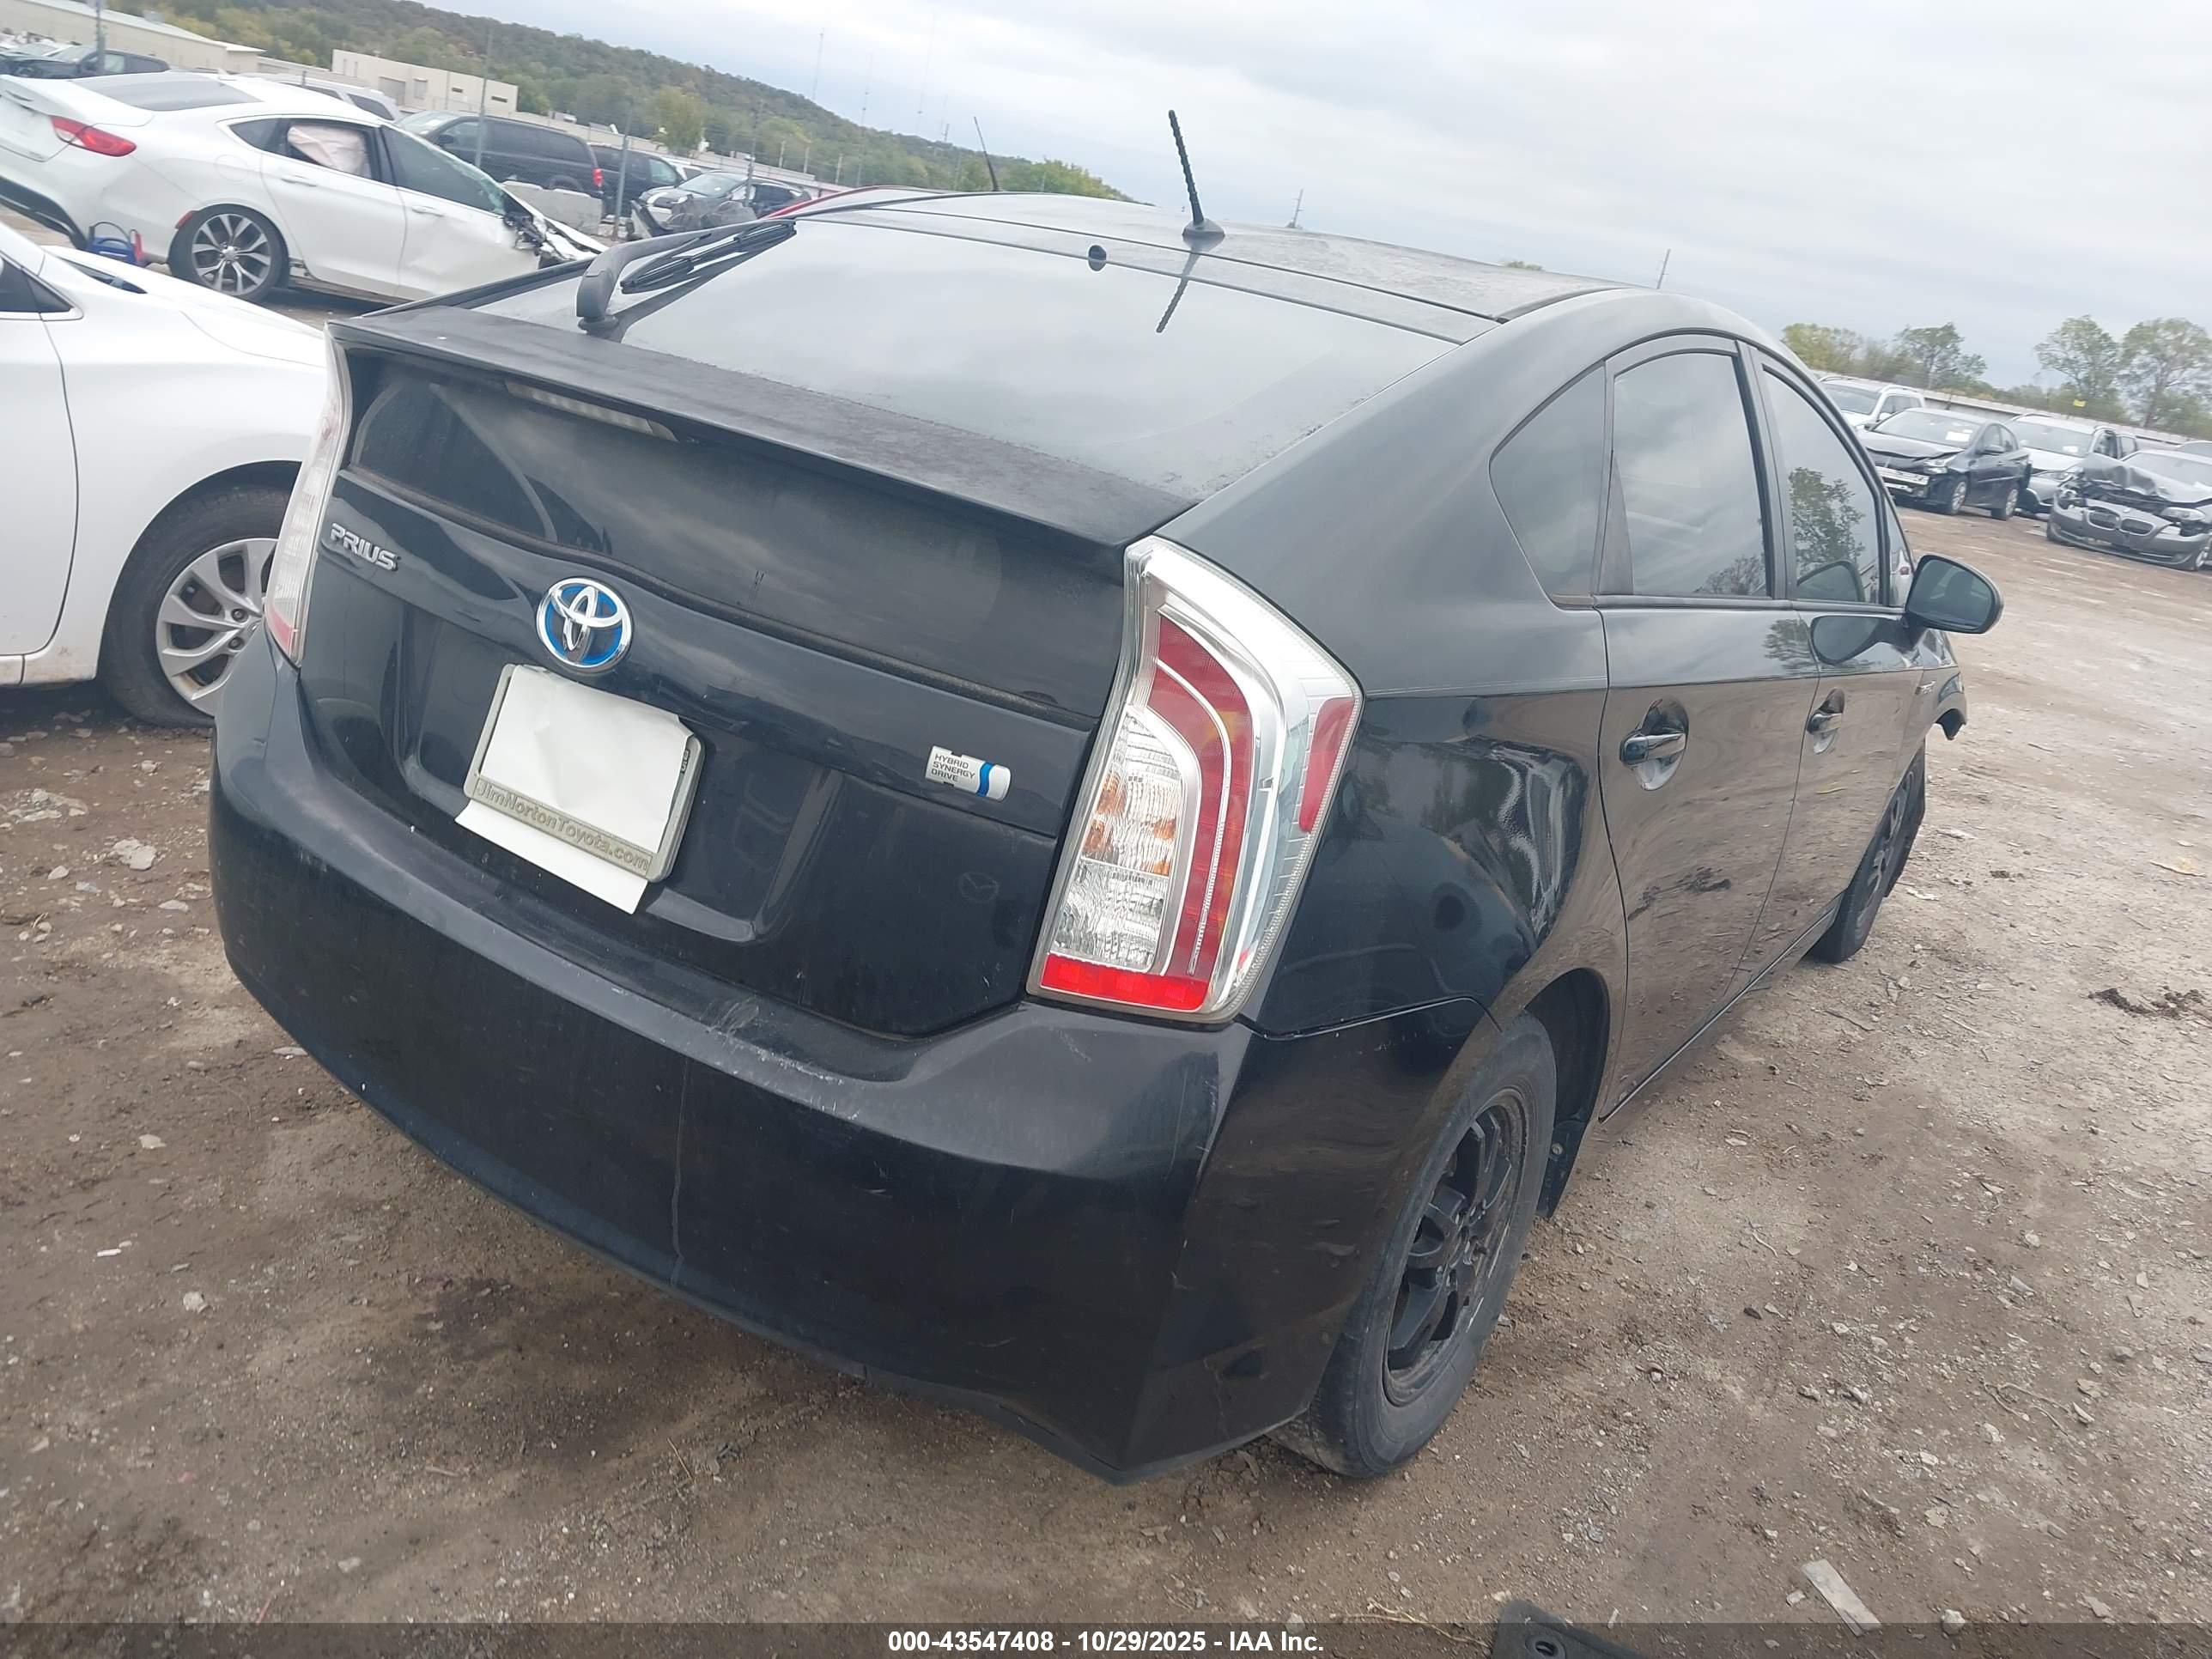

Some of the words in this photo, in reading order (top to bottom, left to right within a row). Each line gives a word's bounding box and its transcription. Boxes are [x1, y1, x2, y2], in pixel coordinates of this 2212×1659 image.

[330, 522, 398, 571] PRIUS
[933, 761, 976, 779] SYNERGY
[934, 753, 969, 769] HYBRID
[931, 769, 959, 782] DRIVE
[477, 781, 650, 870] JimNortonToyota.com
